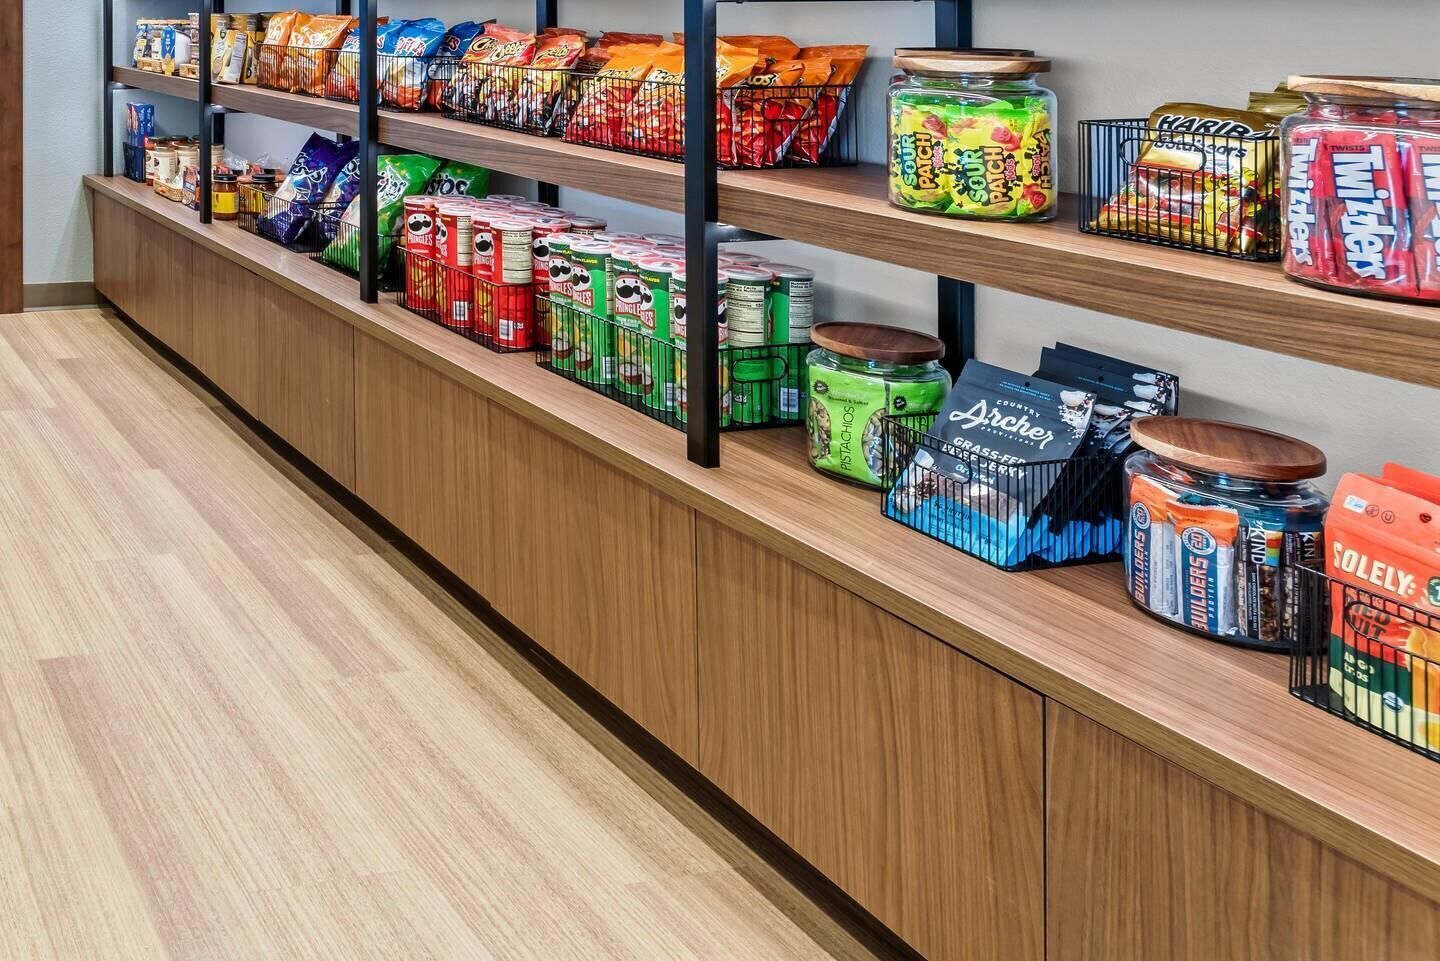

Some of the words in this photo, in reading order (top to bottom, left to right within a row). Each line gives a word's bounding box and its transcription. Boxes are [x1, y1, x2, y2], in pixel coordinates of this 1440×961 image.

[902, 134, 918, 187] SOUR
[916, 132, 939, 190] PATCH
[962, 149, 990, 204] SOUR
[983, 146, 1013, 205] PATCH
[1331, 144, 1396, 280] Twizzlers
[407, 233, 433, 247] PRINGLES
[615, 297, 641, 316] PRINGLE
[948, 399, 1056, 450] Archer
[996, 398, 1041, 418] COUNTRY
[839, 405, 855, 471] PISTACHIOS
[953, 436, 1028, 466] GRASS-FED
[979, 455, 1028, 481] JERKY
[1134, 528, 1146, 604] BUILDERS
[1250, 523, 1267, 565] KIND
[1189, 553, 1210, 632] BUILDERS
